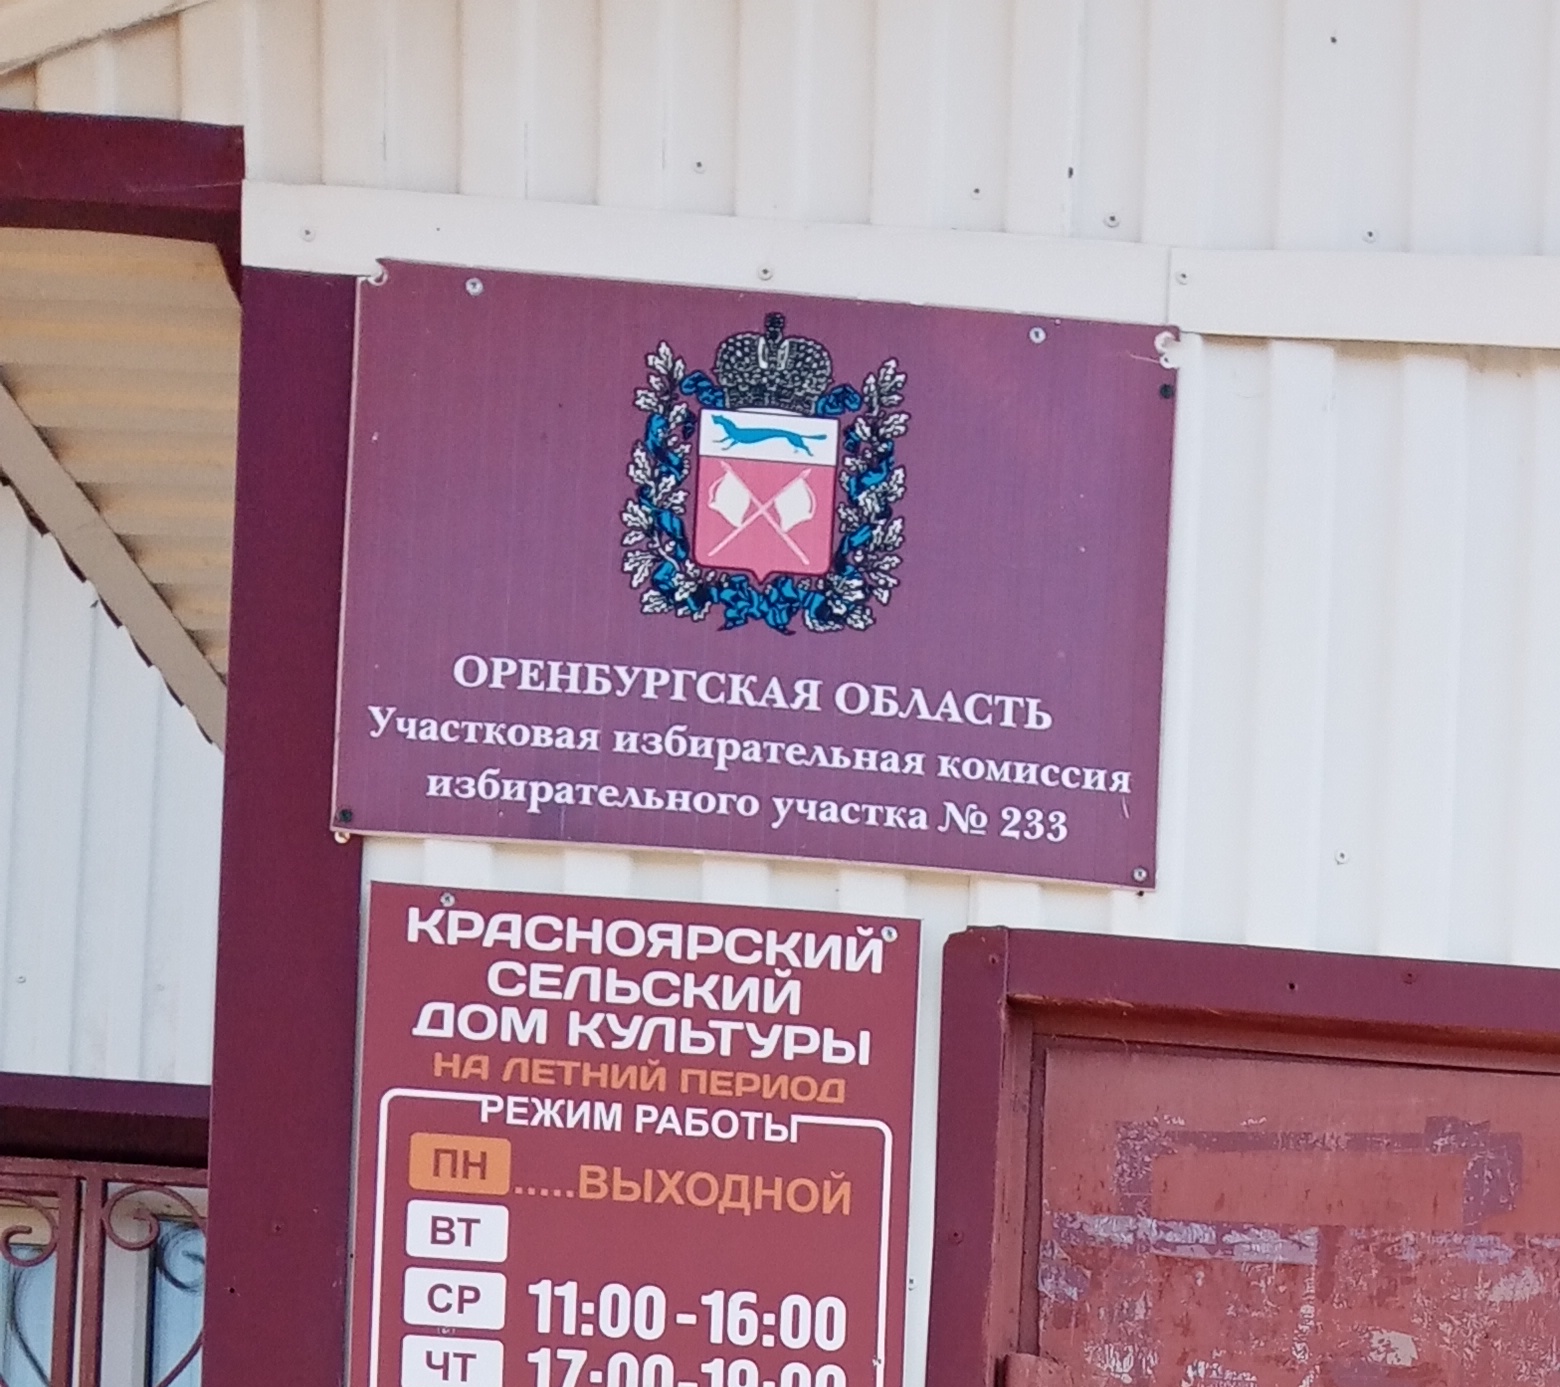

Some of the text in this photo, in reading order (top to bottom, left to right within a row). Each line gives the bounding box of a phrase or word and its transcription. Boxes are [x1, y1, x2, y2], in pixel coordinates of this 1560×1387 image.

[454, 655, 1052, 729] ОРЕНБУРГСКАЯ ОБЛАСТЬ
[368, 706, 1131, 793] Участковая избирательная комиссия
[426, 769, 1067, 842] избирательного участка № 233
[408, 907, 883, 977] КРАСНОЯРСКИЙ
[488, 962, 800, 1014] СЕЛЬСКИЙ
[412, 1002, 870, 1065] ДОМ КУЛЬТУРЫ
[434, 1052, 845, 1103] НА ЛЕТНИЙ ПЕРИОД
[481, 1095, 797, 1143] РЕЖИМ РАБОТЫ
[433, 1149, 487, 1180] ПН
[430, 1216, 480, 1246] ВТ
[427, 1284, 480, 1314] СР
[425, 1351, 476, 1382] ЧТ
